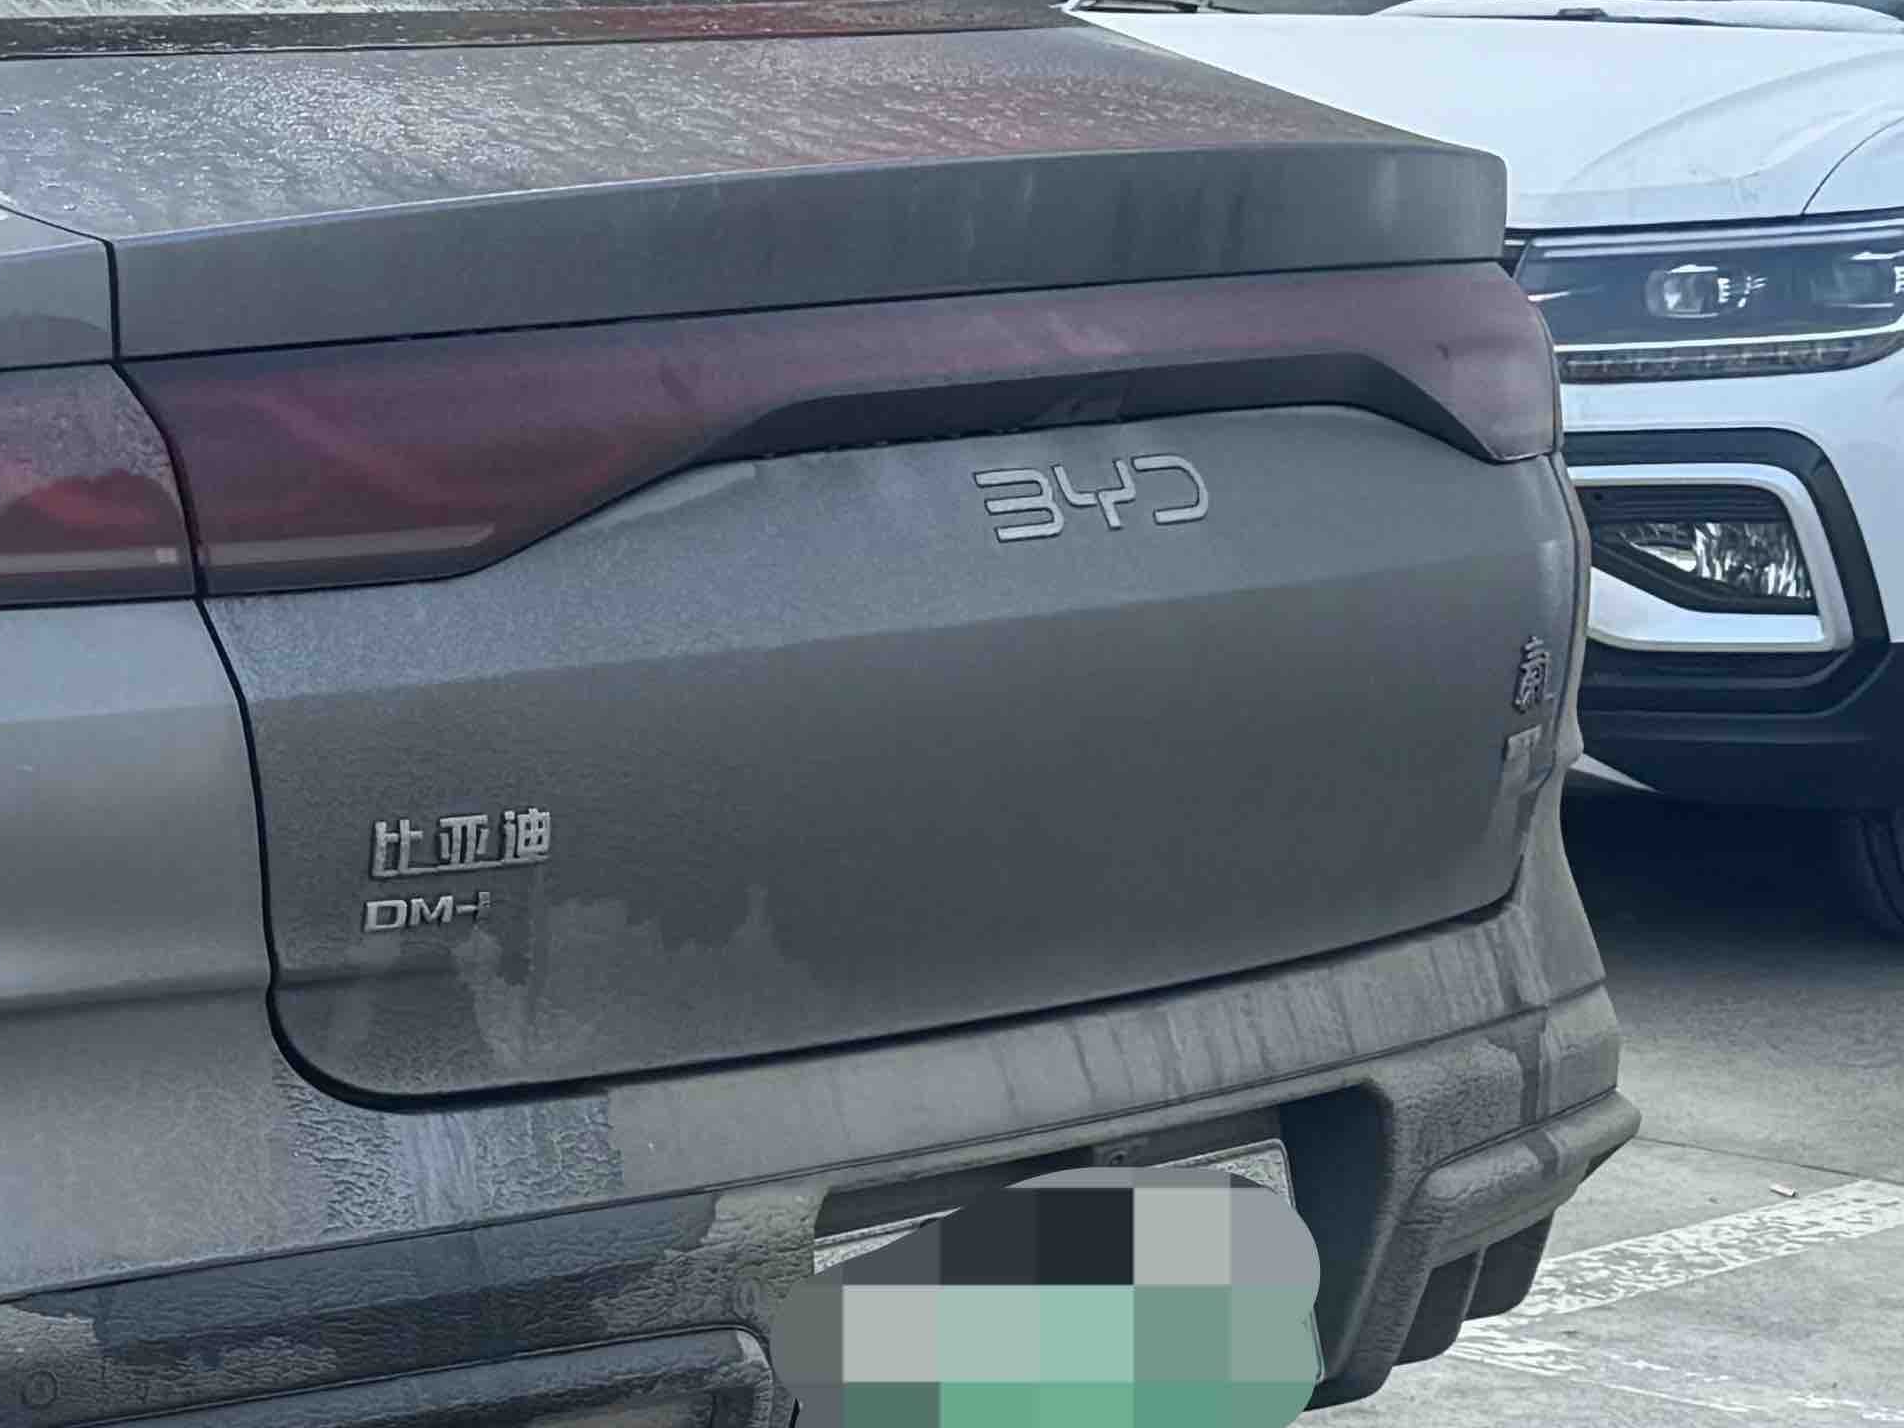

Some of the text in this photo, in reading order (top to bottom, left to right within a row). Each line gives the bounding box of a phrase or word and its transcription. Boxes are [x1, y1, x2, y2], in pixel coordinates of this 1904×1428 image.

[973, 453, 1209, 544] BYD
[371, 808, 551, 877] 比亚迪
